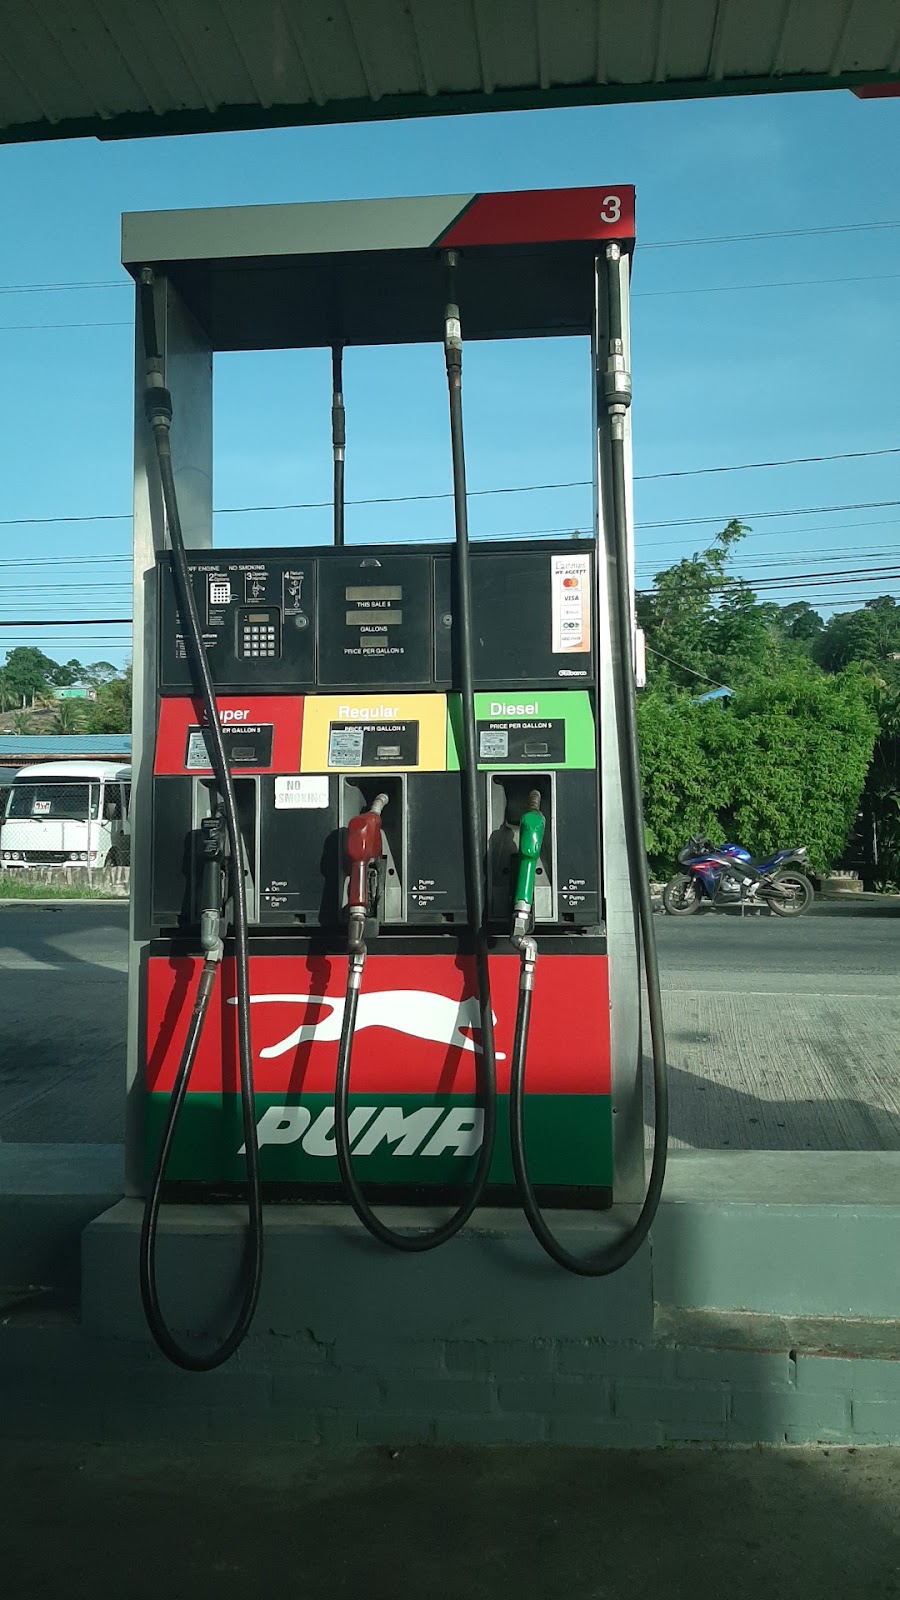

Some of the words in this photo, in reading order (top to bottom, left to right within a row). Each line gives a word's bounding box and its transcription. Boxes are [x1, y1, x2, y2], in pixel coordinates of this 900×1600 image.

[600, 195, 621, 223] 3
[208, 573, 214, 581] 2
[246, 572, 252, 580] 3
[284, 571, 290, 579] 4
[338, 704, 399, 721] Regular
[490, 701, 539, 716] Diesel
[286, 780, 301, 790] NO
[278, 793, 326, 803] SMOKING
[237, 1106, 485, 1157] PUMA
